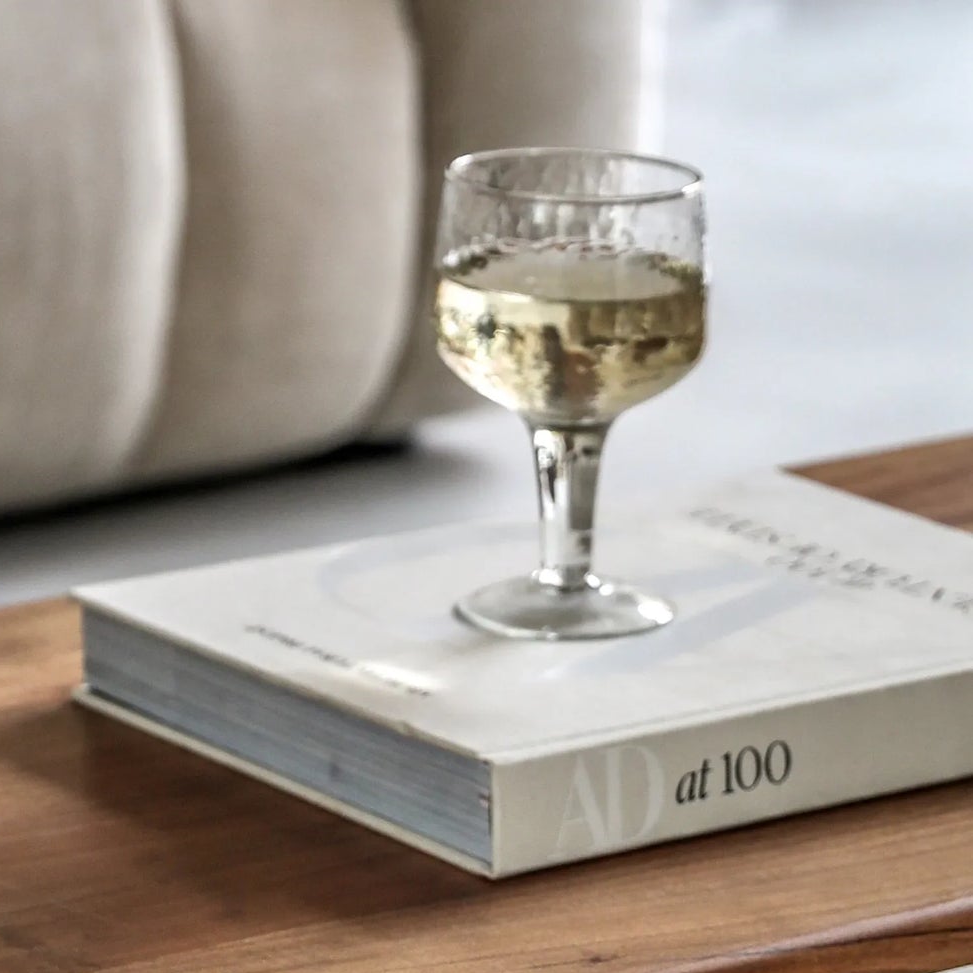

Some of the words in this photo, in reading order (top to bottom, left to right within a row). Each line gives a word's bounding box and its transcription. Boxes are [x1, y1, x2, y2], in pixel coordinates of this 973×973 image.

[547, 744, 665, 859] AD
[674, 757, 711, 805] at
[721, 739, 793, 796] 100
